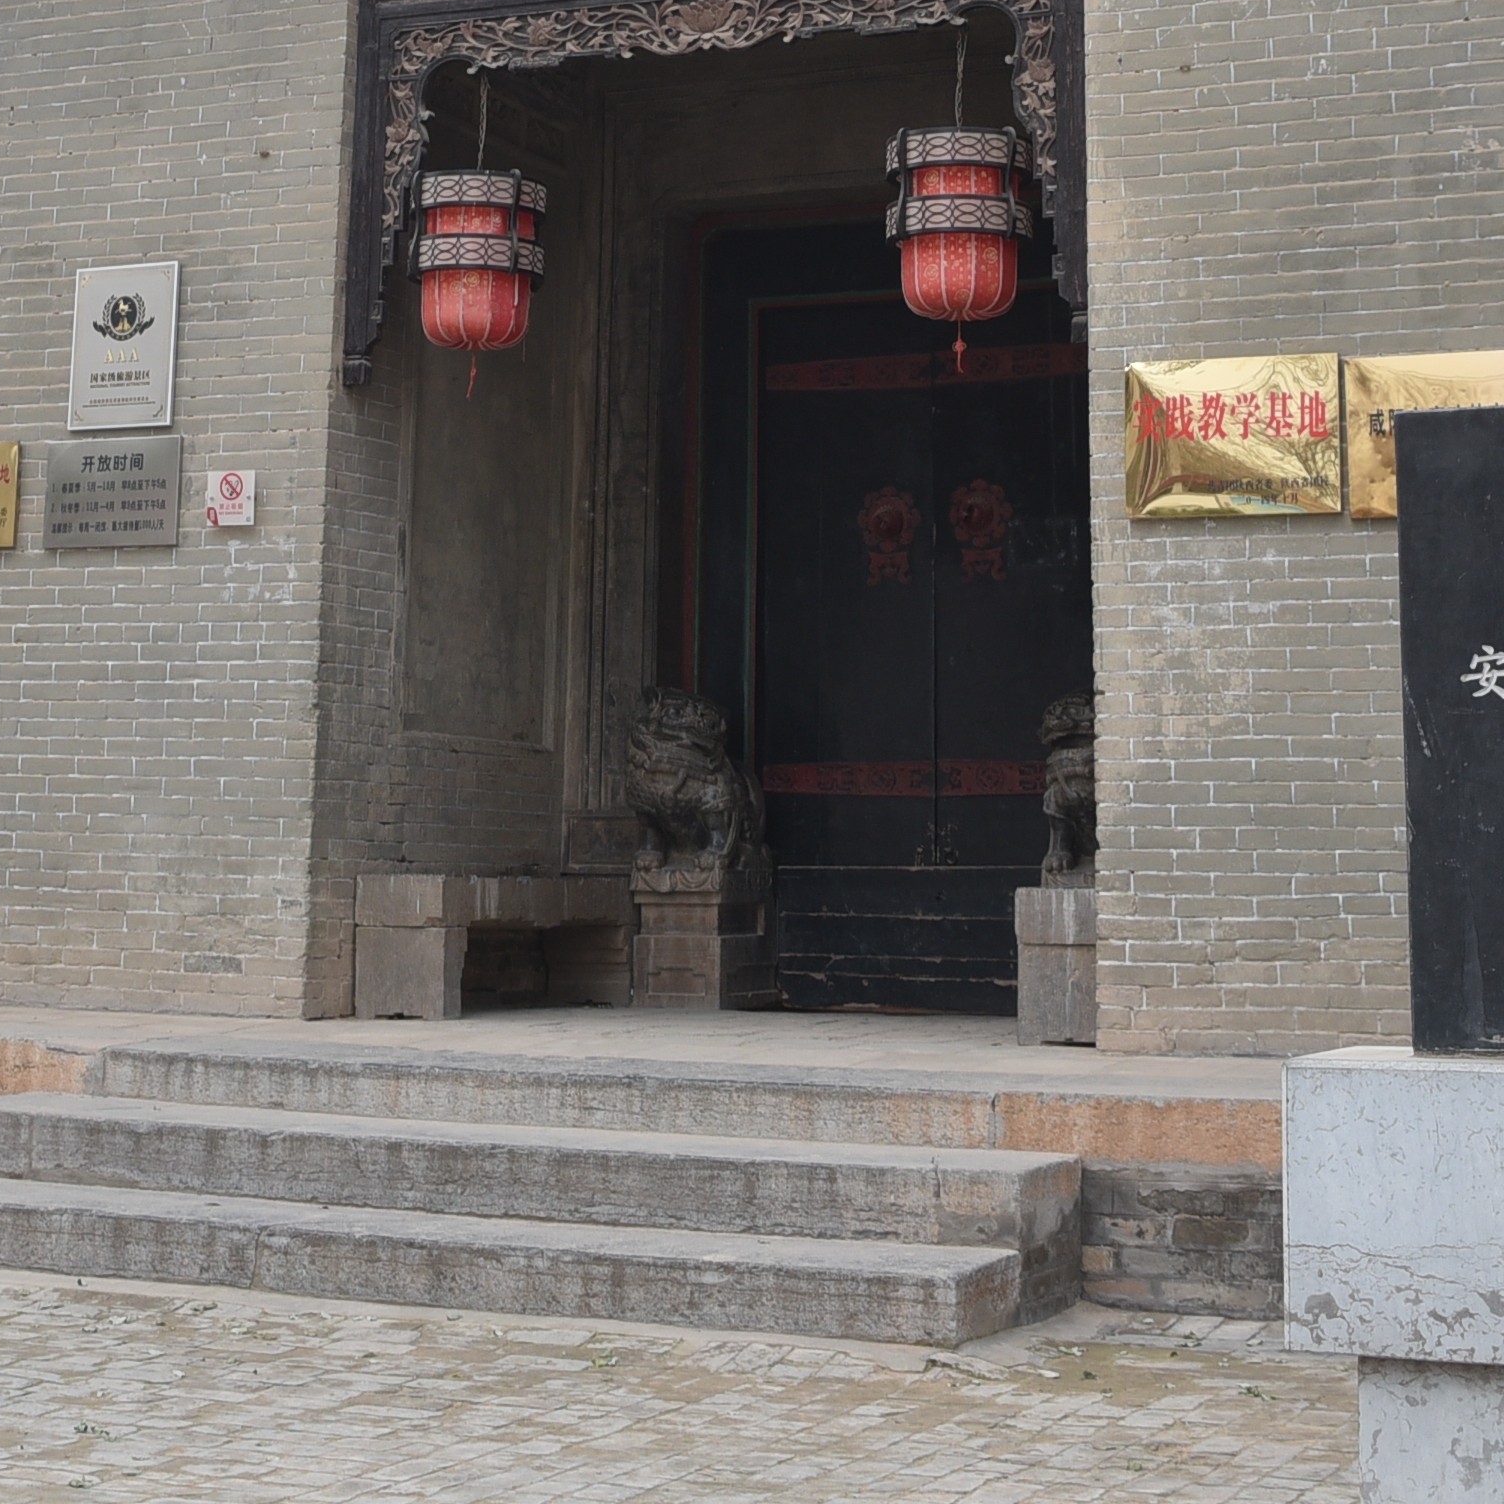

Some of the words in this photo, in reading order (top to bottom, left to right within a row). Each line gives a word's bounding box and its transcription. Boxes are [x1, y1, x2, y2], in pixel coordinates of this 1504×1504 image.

[1133, 391, 1330, 442] 实践教学基地
[81, 453, 144, 473] 开放时间
